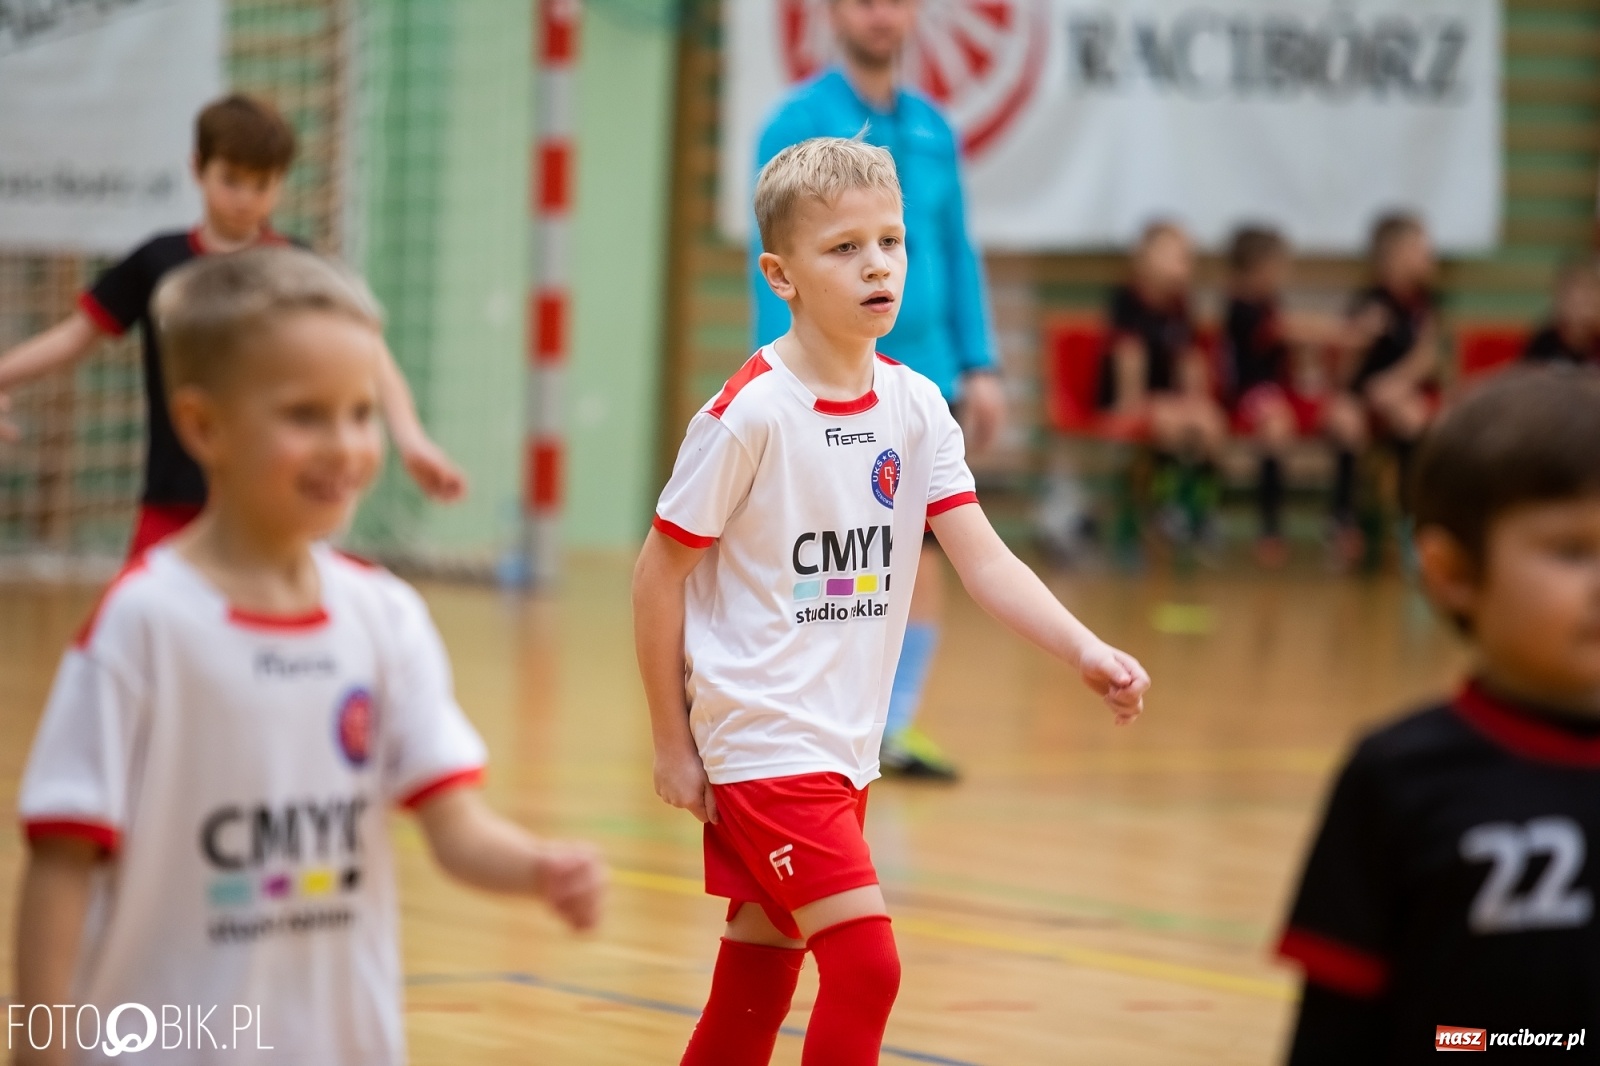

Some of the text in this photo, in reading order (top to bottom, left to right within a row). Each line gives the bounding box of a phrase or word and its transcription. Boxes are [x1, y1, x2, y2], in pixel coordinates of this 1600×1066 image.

[872, 459, 883, 483] UKS
[795, 602, 849, 624] studio
[1459, 816, 1594, 936] 22
